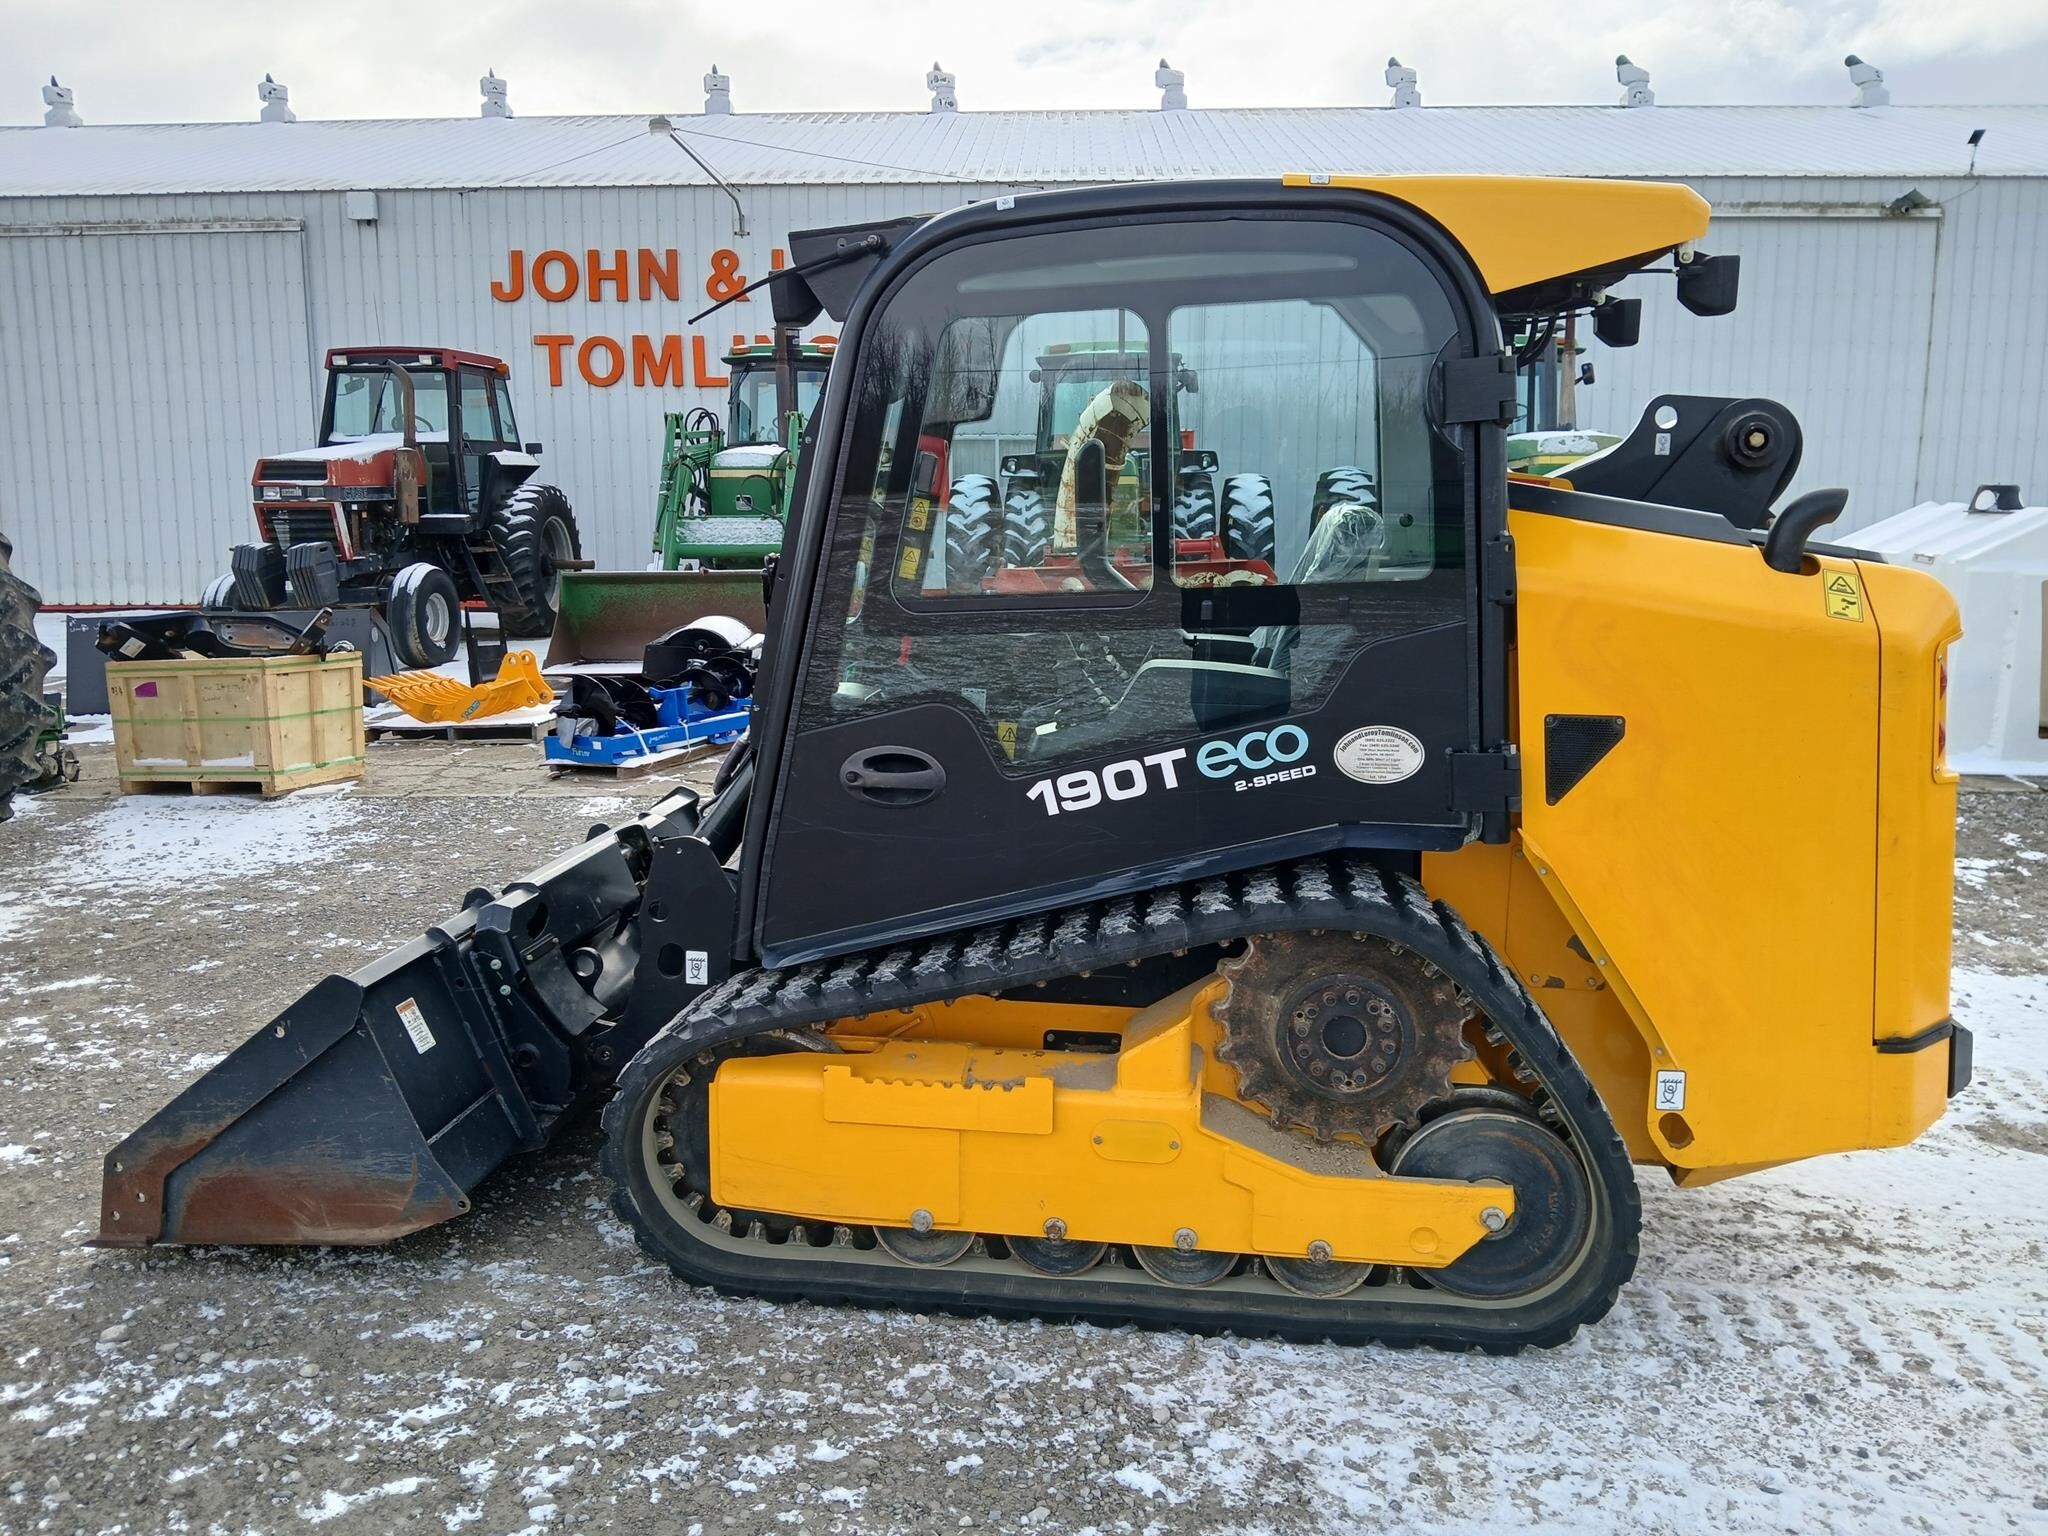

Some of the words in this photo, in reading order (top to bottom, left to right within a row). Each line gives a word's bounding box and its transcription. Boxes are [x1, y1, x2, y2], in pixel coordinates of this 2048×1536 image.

[490, 248, 680, 303] JOHN
[706, 248, 750, 303] &
[533, 334, 839, 388] TOML
[1196, 724, 1310, 779] eco
[1234, 764, 1317, 792] 2-SPEED
[1025, 747, 1187, 817] 190T
